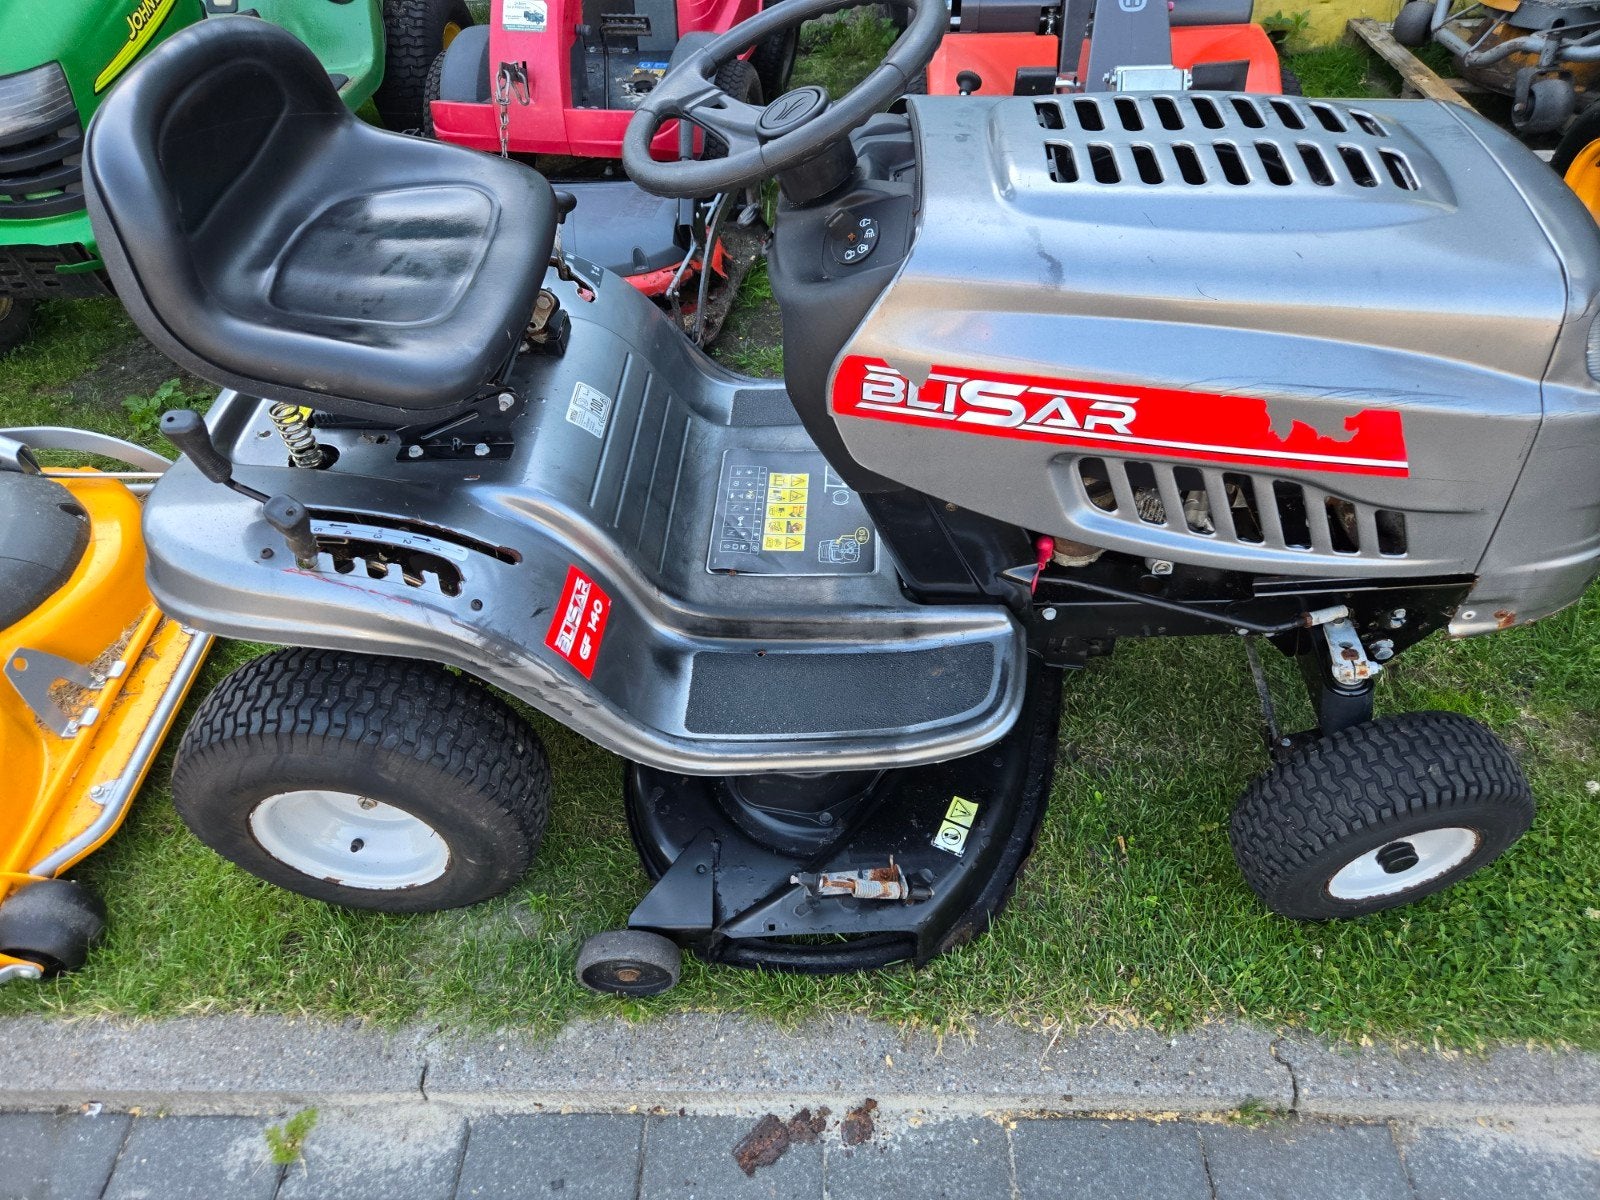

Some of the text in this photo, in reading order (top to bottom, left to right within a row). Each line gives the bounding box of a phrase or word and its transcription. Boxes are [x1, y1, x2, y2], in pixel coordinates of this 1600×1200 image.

[859, 367, 1138, 435] BLISAR
[554, 576, 592, 657] BLISAR
[579, 599, 603, 660] GF 140
